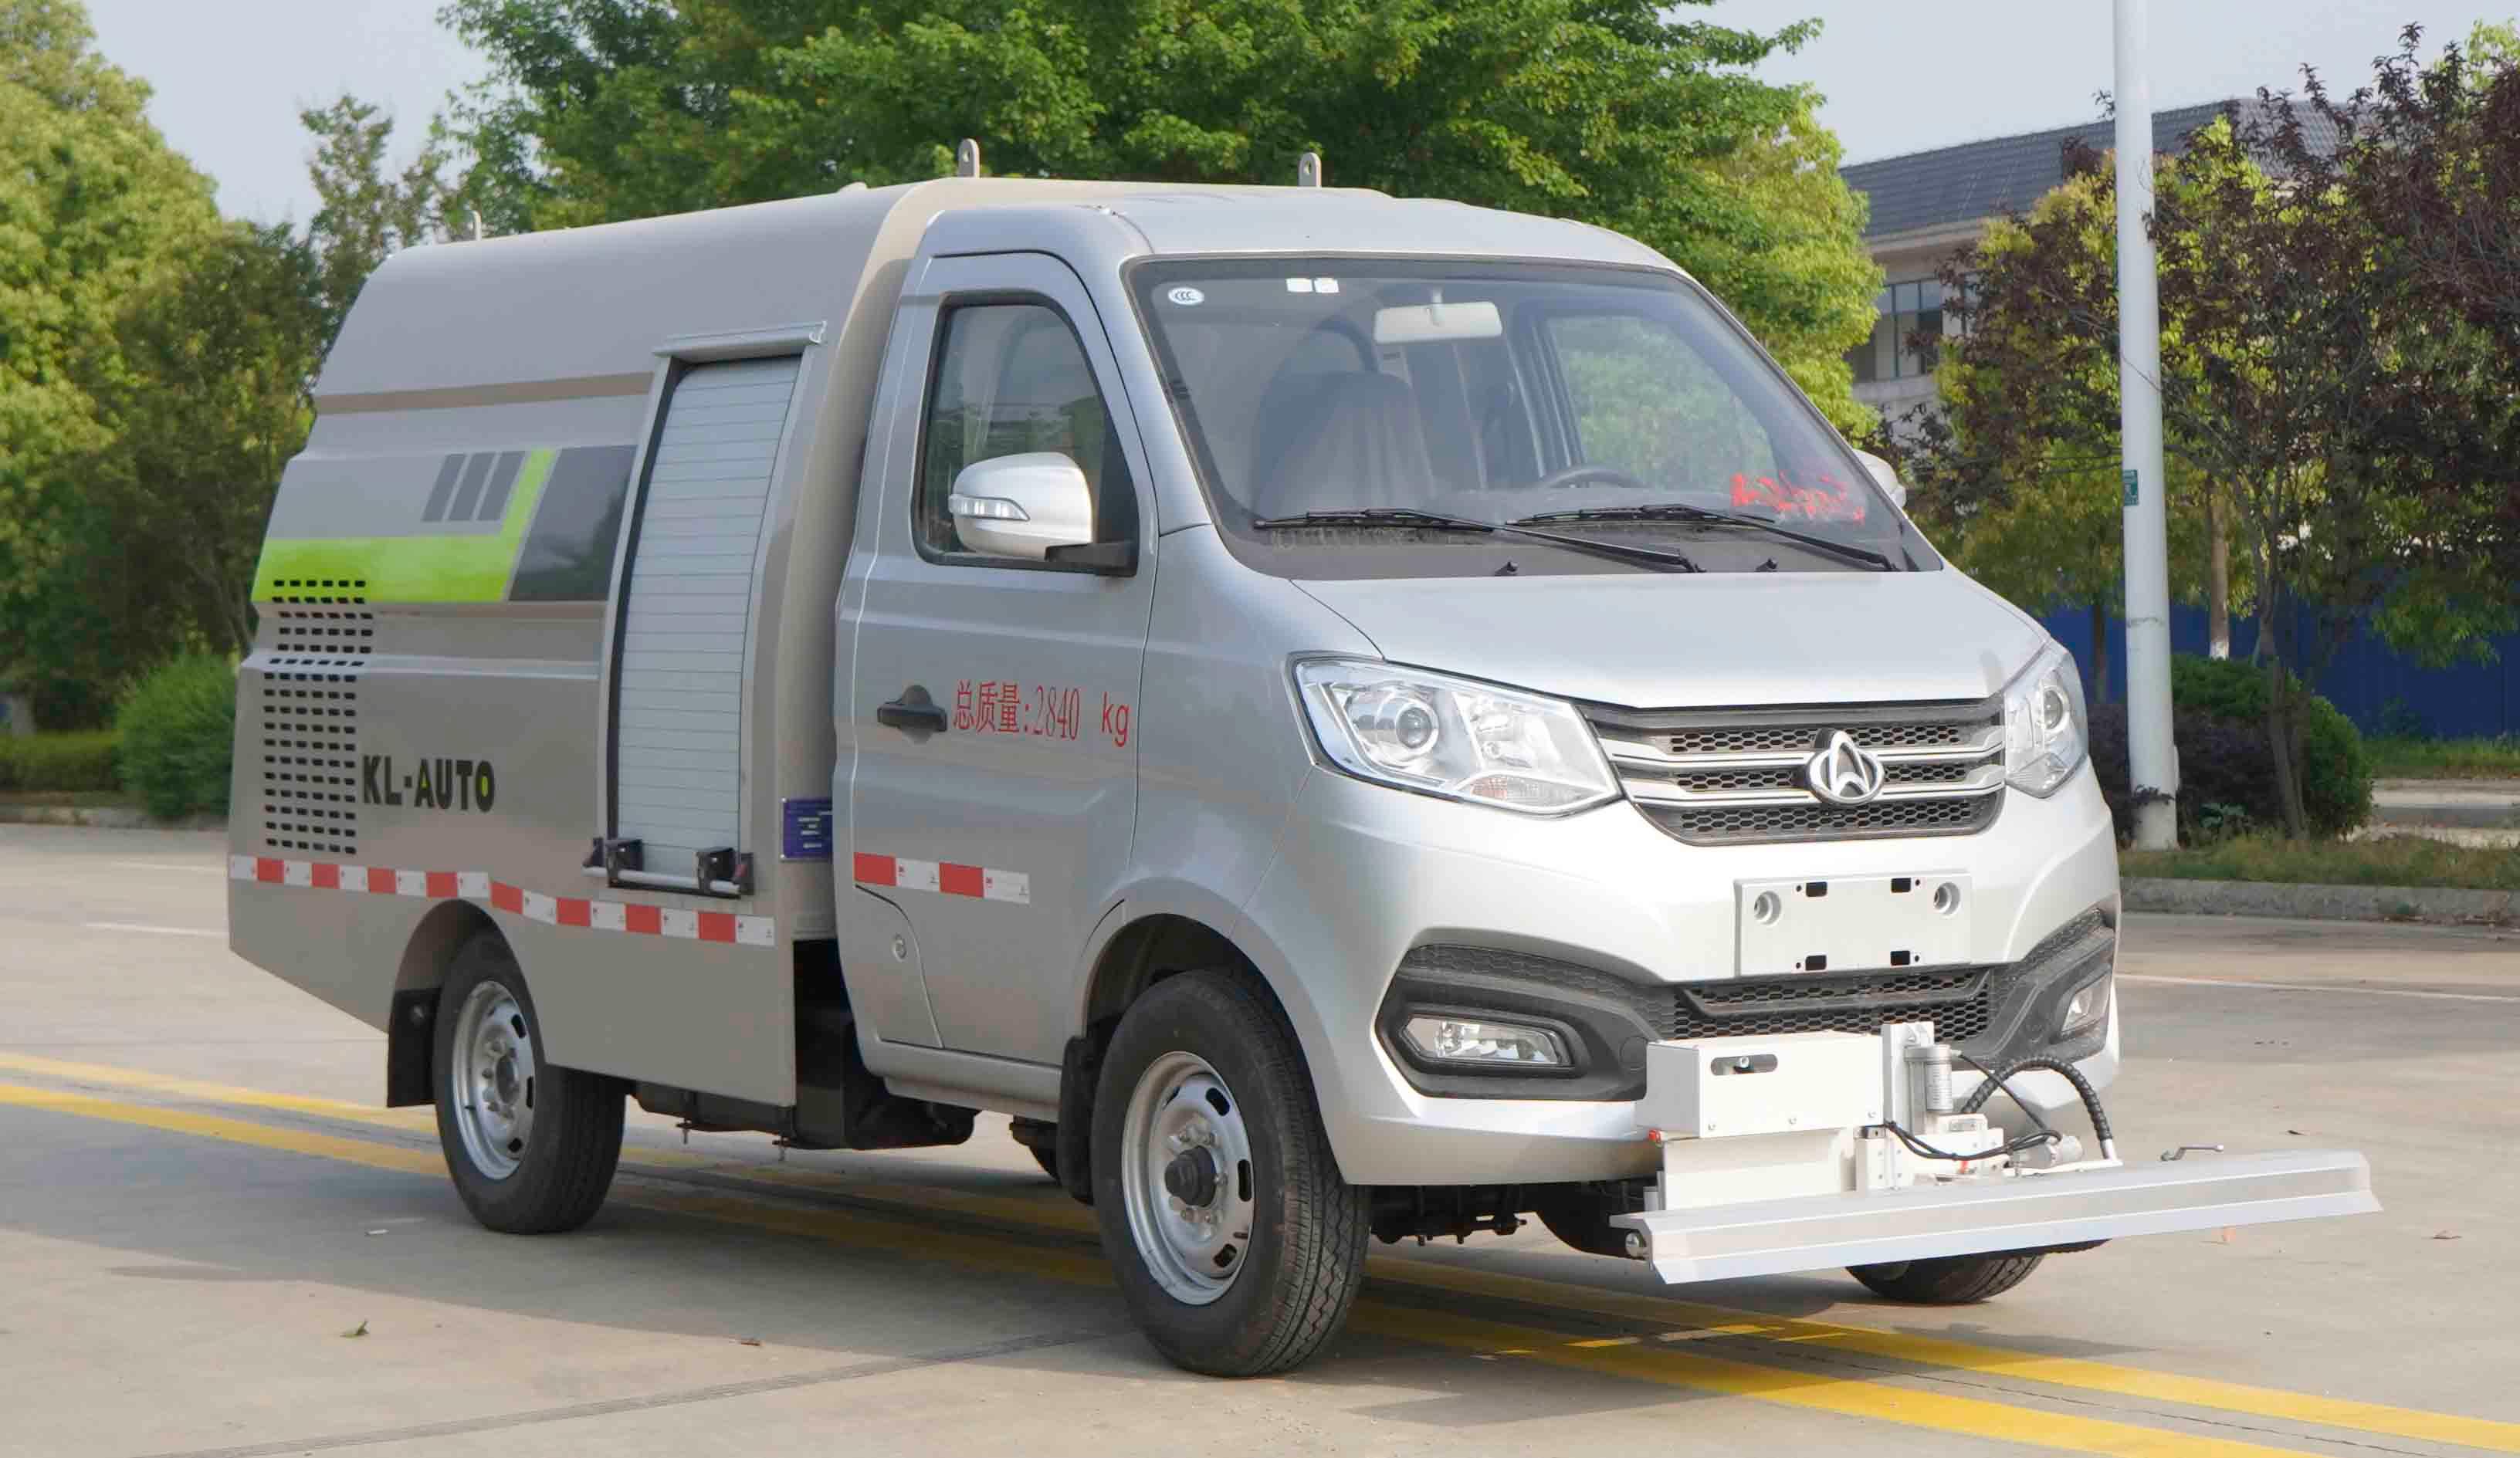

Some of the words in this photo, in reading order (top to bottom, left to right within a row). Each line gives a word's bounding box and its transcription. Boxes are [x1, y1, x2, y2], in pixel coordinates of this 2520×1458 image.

[953, 678, 1081, 741] 总质量:2840
[1101, 692, 1130, 747] kg
